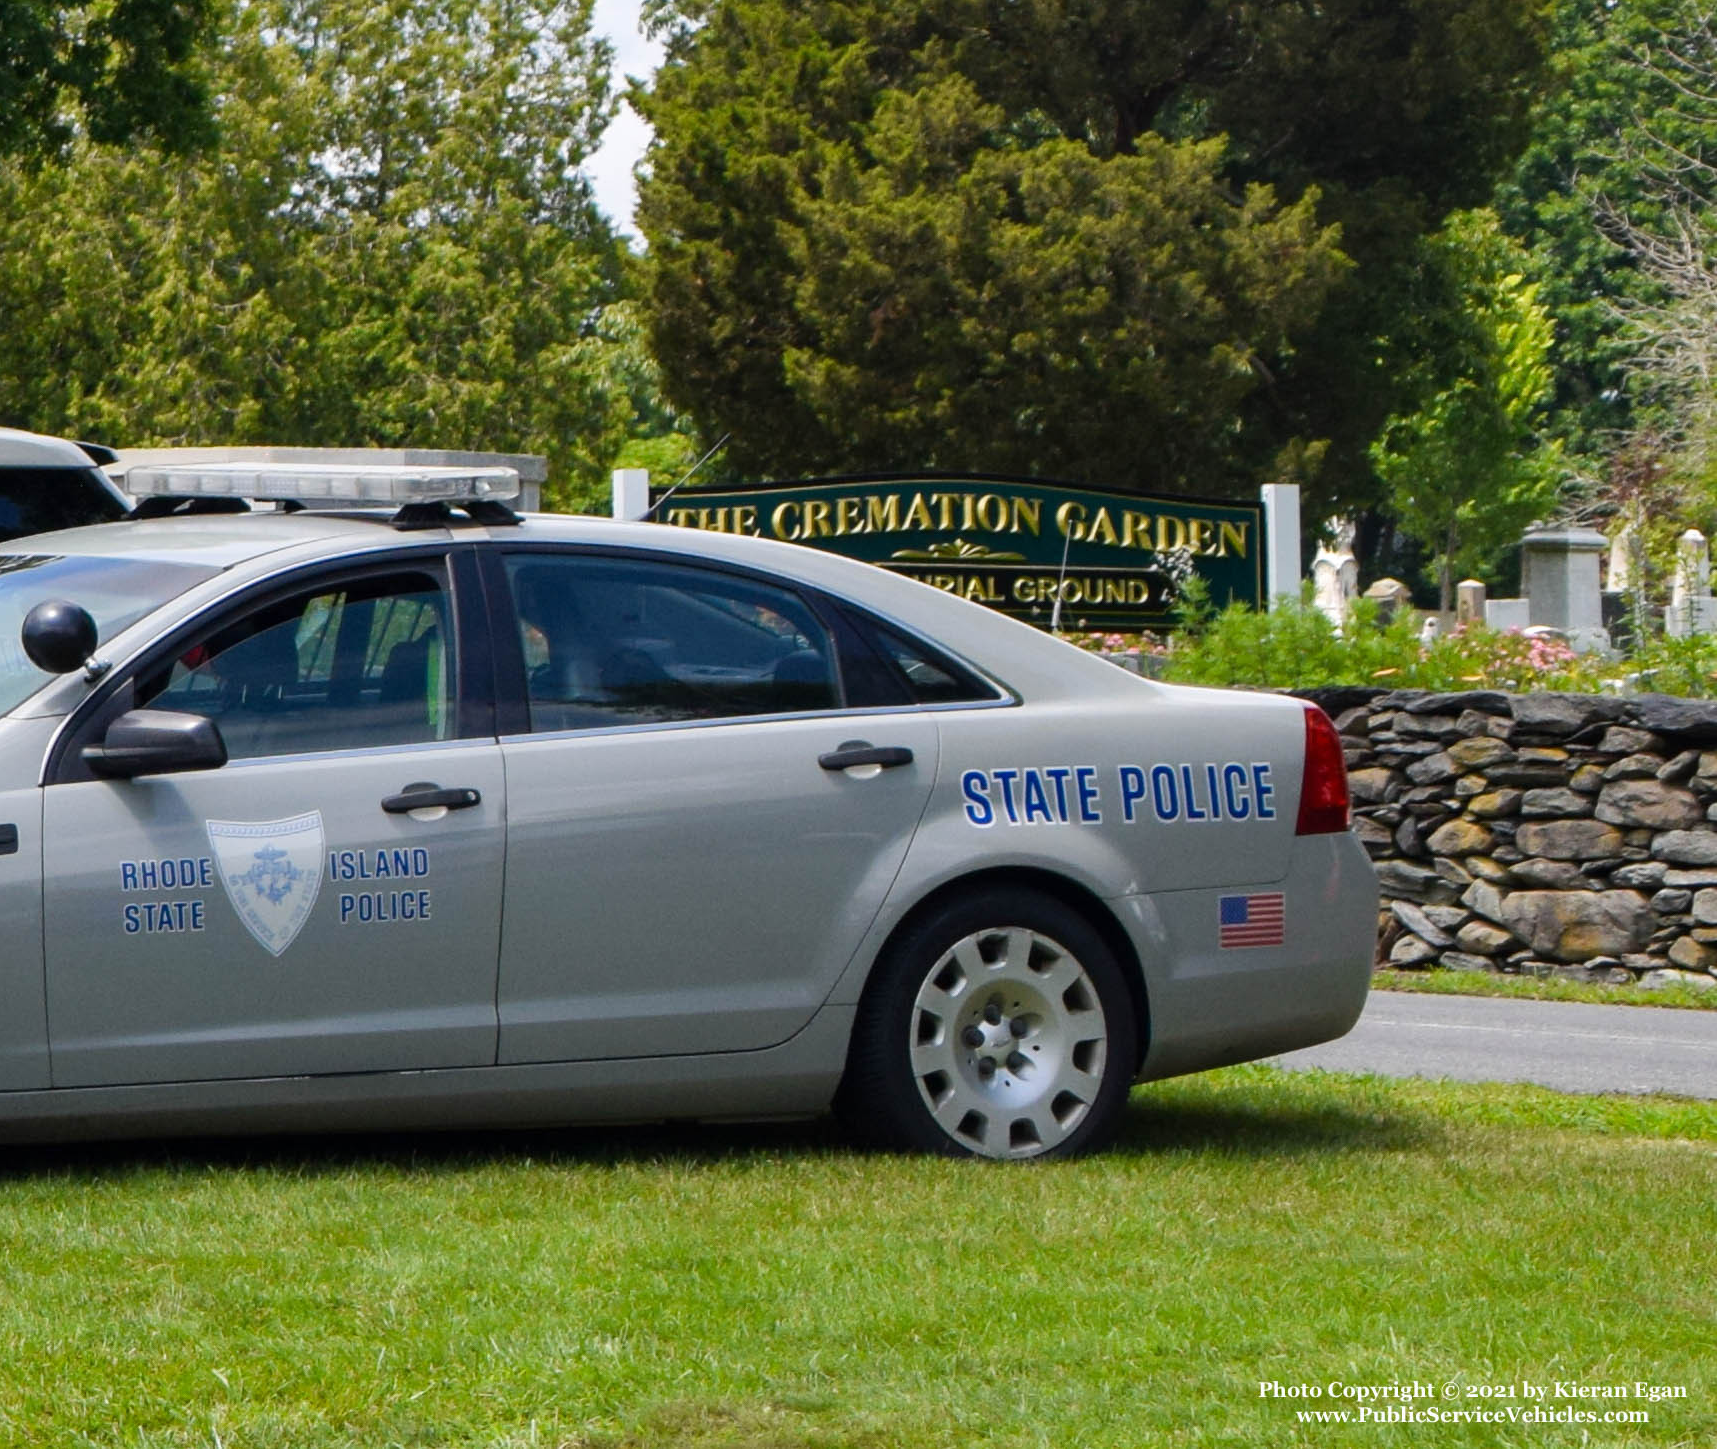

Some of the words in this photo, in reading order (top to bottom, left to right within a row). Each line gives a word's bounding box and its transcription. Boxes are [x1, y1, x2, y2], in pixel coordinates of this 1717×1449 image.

[667, 505, 761, 538] THE
[771, 492, 1043, 540] CREMATION
[1055, 501, 1251, 559] GARDEN
[1013, 575, 1150, 604] GROUND
[960, 765, 1103, 829] STATE
[1116, 761, 1277, 824] POLICE
[120, 858, 214, 891] RHODE
[329, 847, 430, 881] ISLAND
[124, 901, 206, 934] STATE
[339, 889, 431, 924] POLICE
